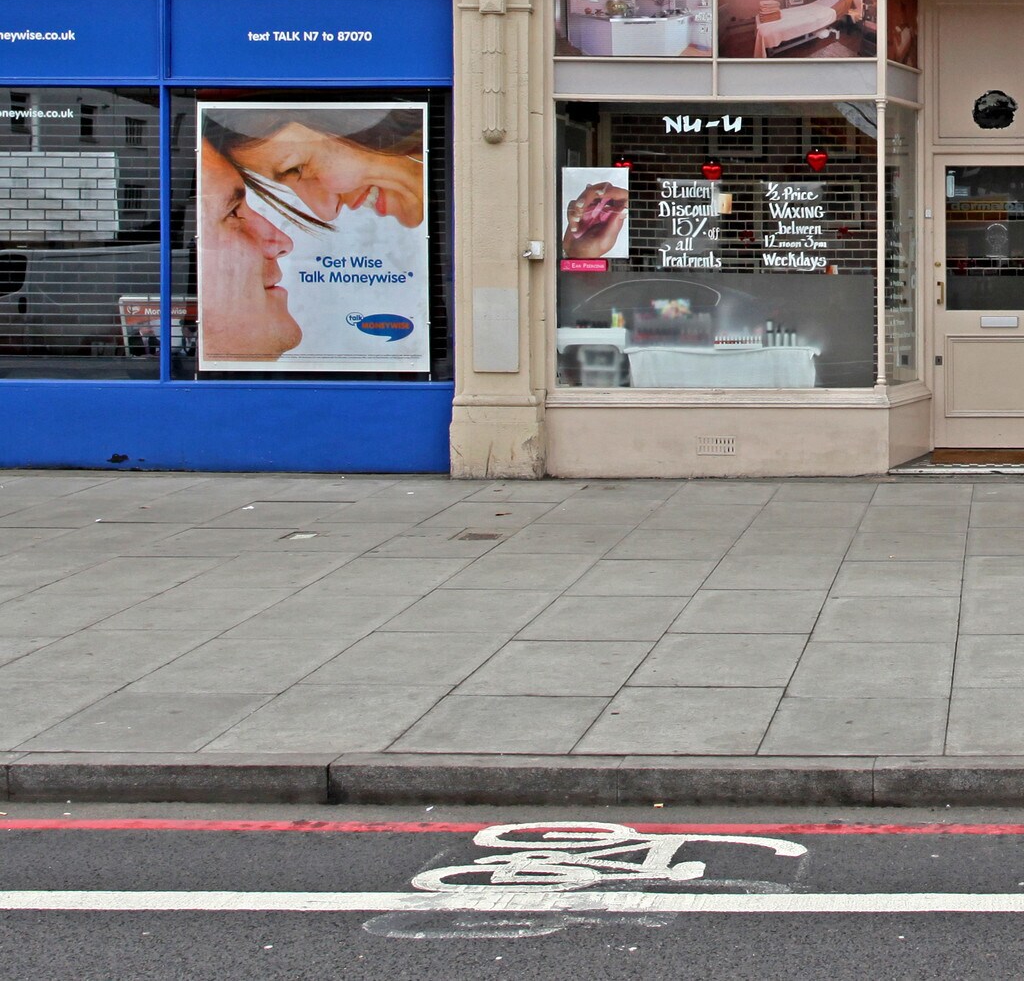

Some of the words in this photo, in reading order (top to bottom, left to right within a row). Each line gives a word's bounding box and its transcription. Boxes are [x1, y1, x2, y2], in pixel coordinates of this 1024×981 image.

[248, 31, 270, 41] text
[273, 31, 300, 41] TALK
[303, 31, 319, 41] N7
[322, 31, 334, 41] to
[337, 31, 373, 41] 87070
[782, 186, 818, 201] Price
[708, 227, 720, 241] off
[775, 221, 823, 235] between
[675, 237, 694, 252] all
[350, 256, 383, 268] Wise
[658, 244, 722, 268] Treatments
[762, 251, 828, 272] Weekdays
[299, 271, 325, 283] Talk
